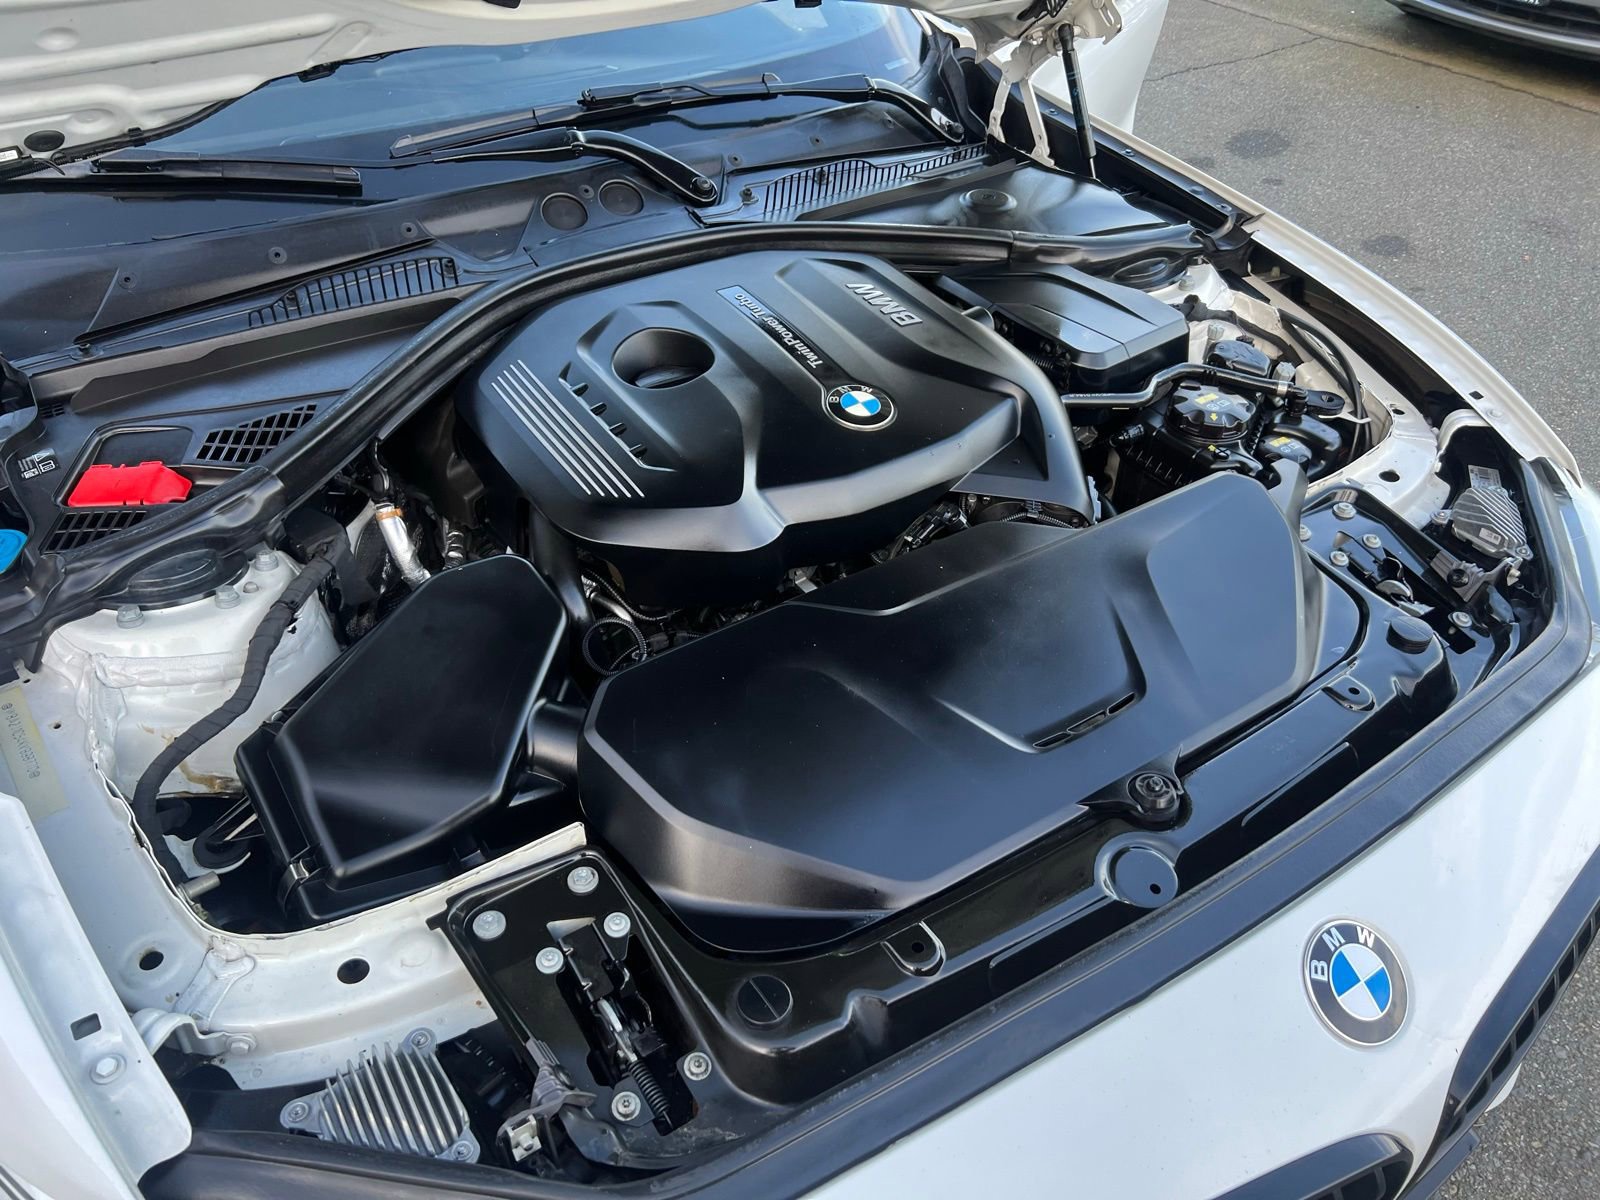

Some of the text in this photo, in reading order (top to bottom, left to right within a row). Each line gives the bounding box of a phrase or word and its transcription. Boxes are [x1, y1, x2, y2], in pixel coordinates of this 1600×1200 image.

[734, 293, 824, 369] TwinPower Turbo
[845, 282, 924, 327] BMW
[1311, 926, 1375, 981] BMW
